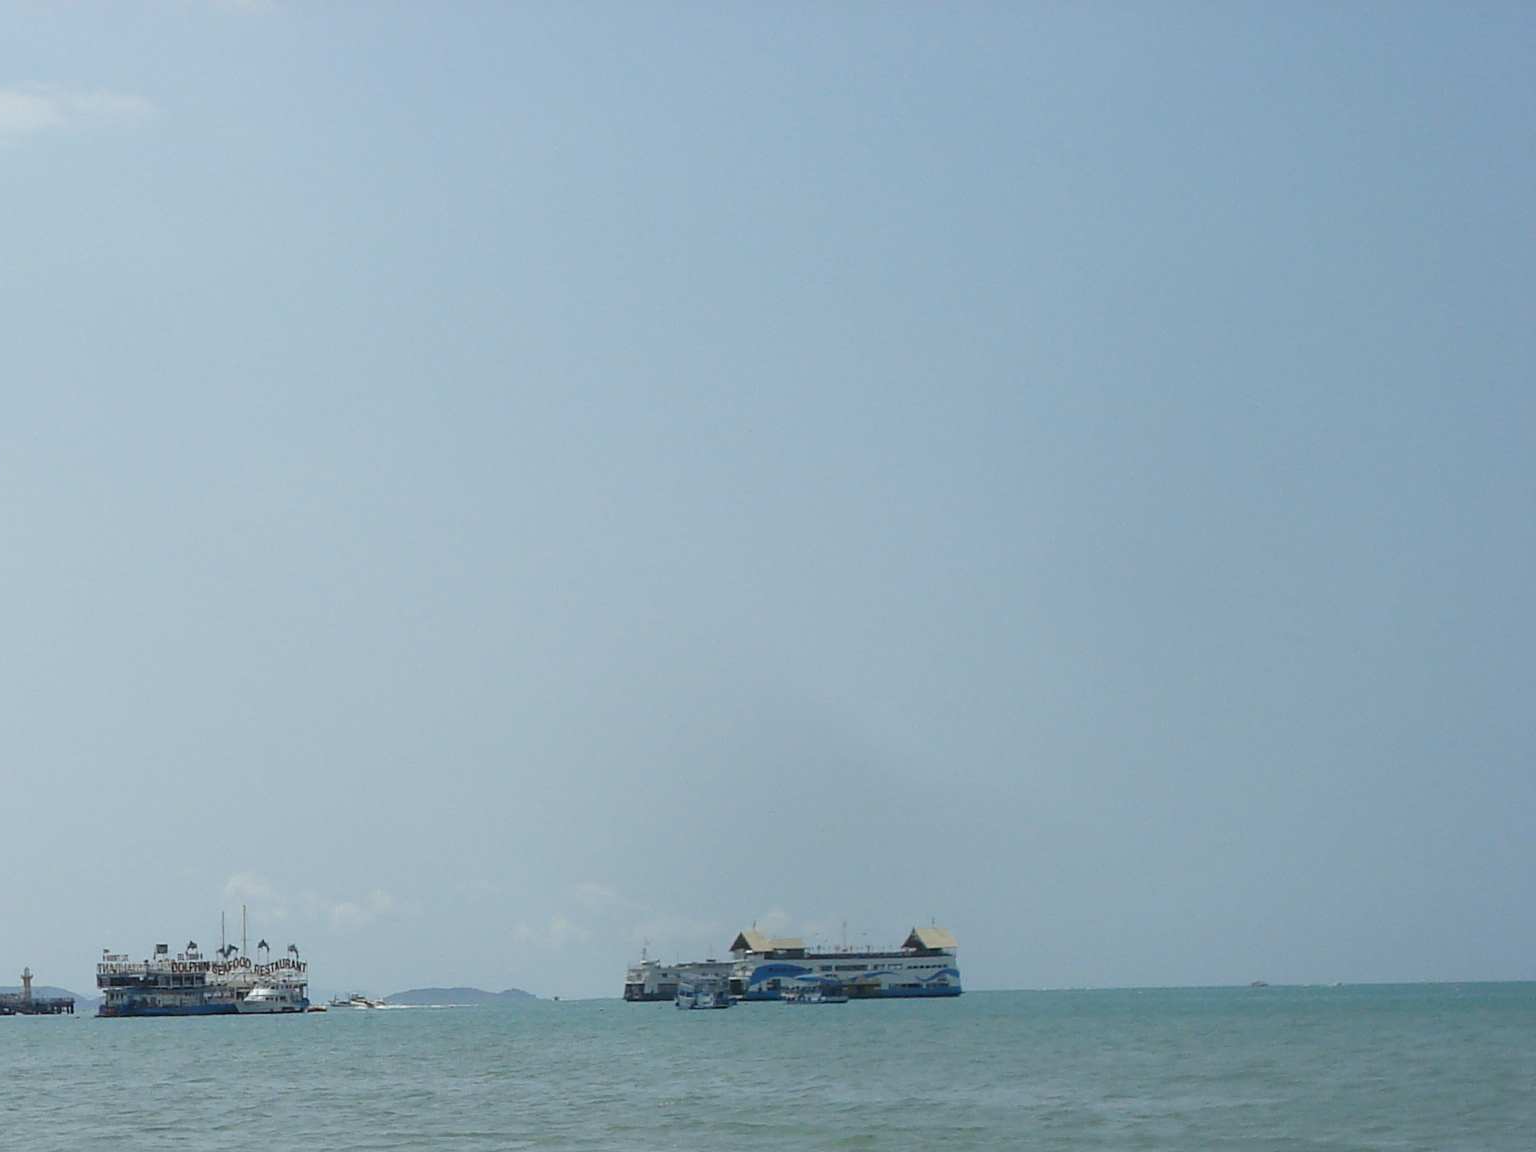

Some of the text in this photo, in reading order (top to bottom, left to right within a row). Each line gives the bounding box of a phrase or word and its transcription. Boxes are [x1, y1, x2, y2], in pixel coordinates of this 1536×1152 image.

[171, 961, 210, 973] DOLPHIN
[212, 956, 252, 976] SEAFOOD
[254, 958, 307, 977] RESTAURANT
